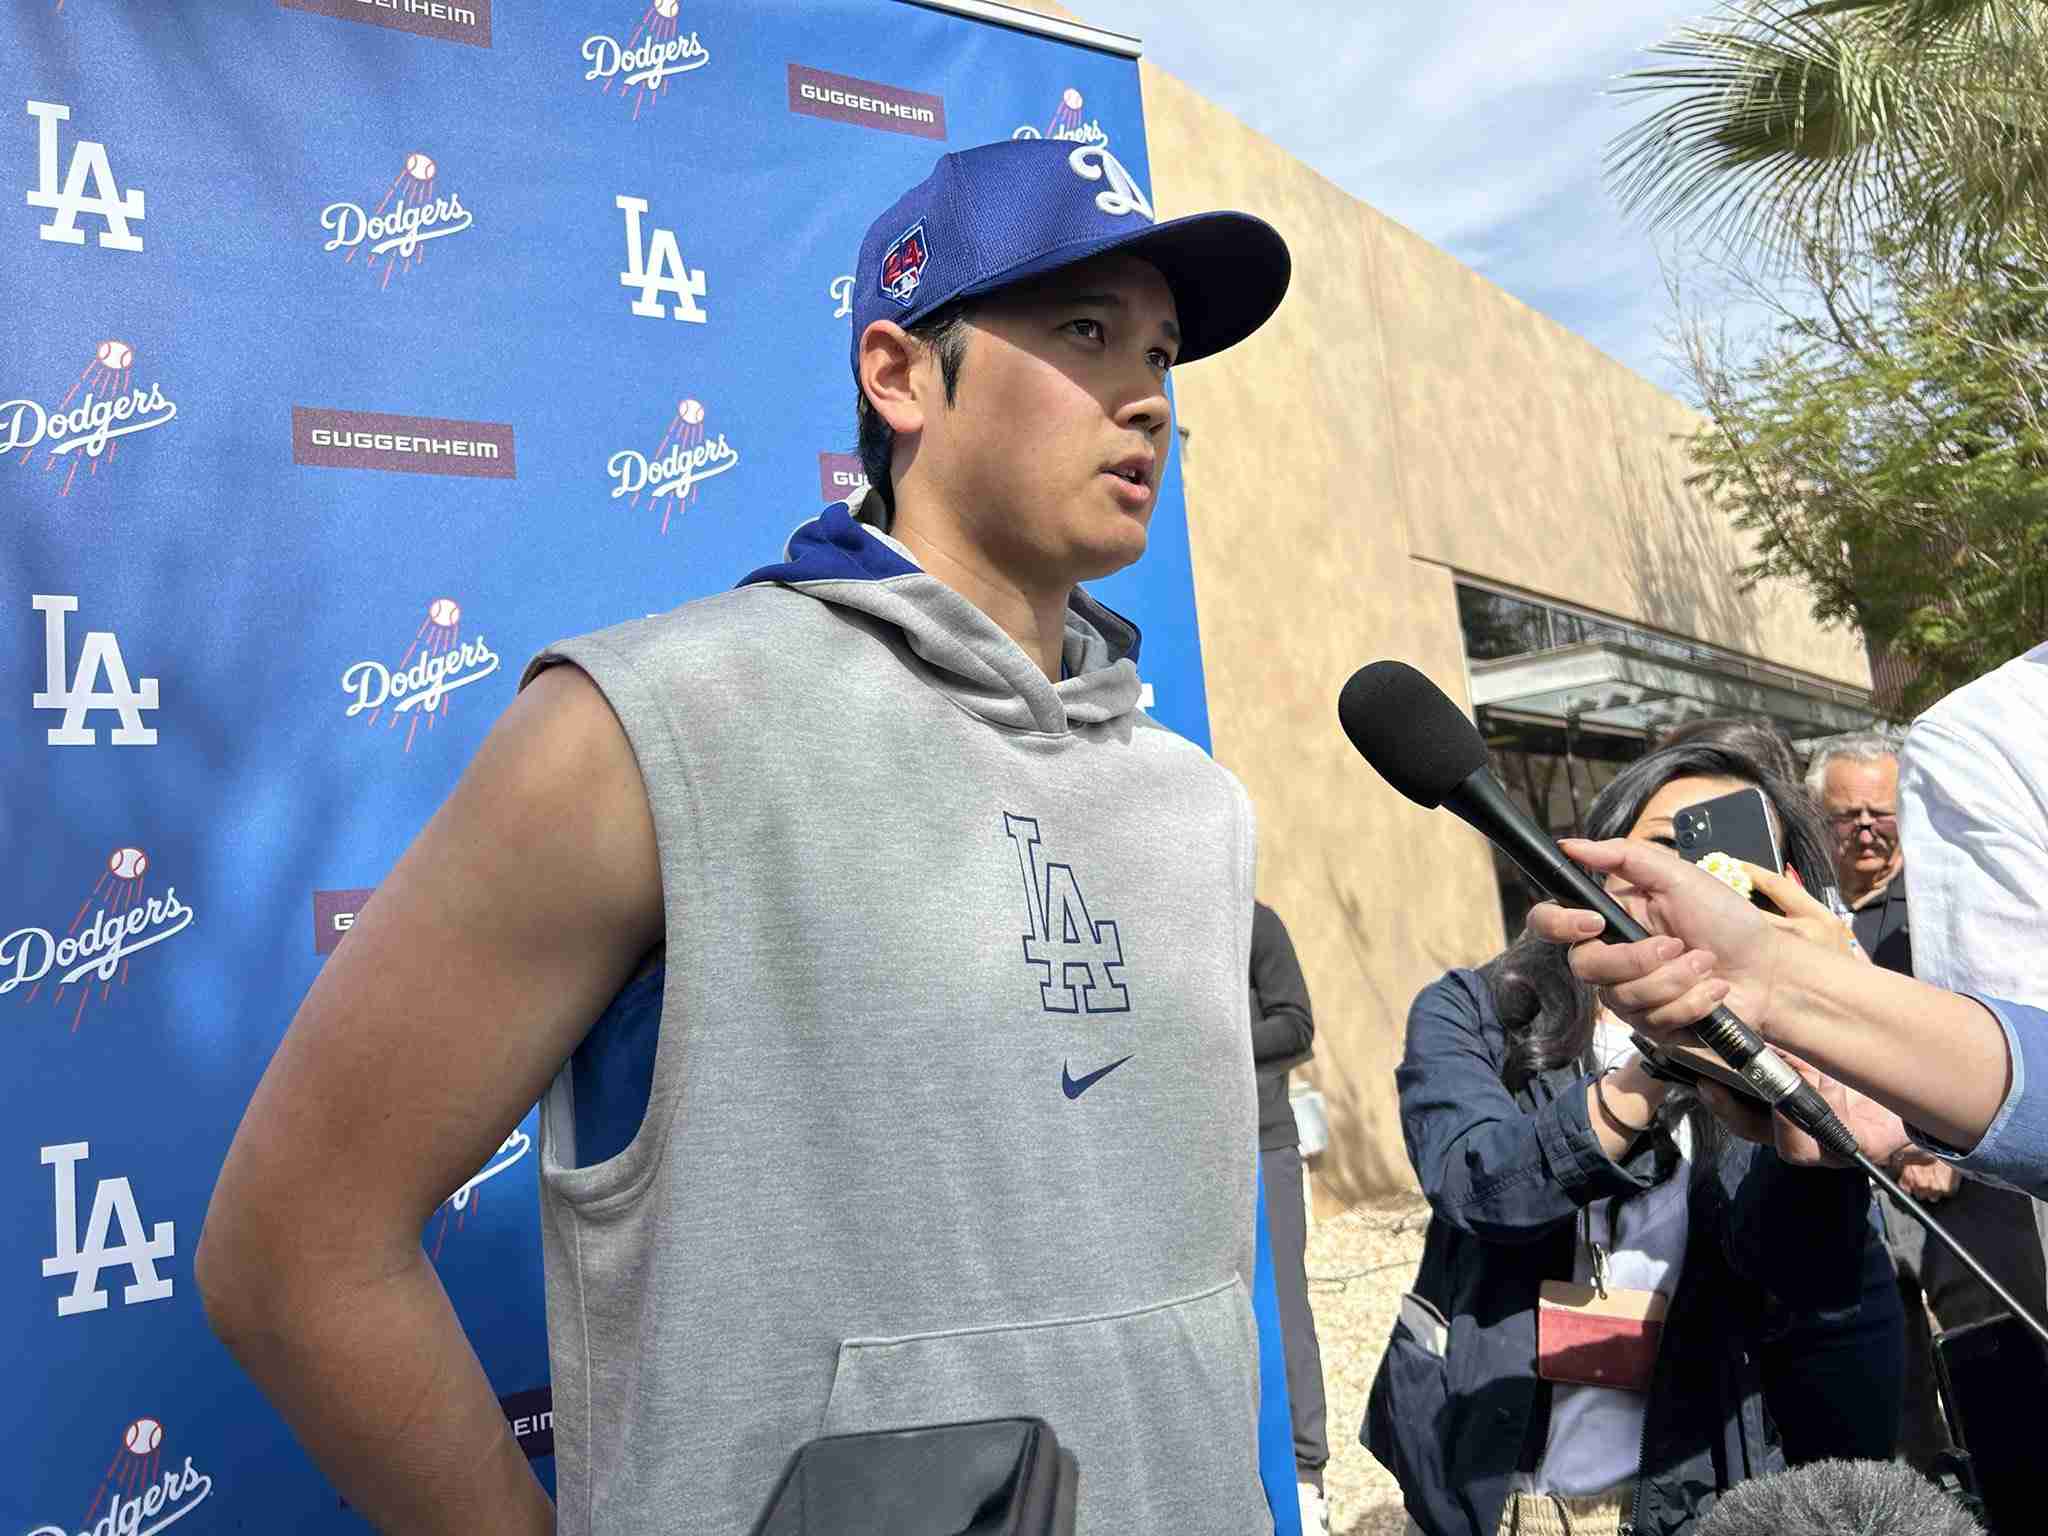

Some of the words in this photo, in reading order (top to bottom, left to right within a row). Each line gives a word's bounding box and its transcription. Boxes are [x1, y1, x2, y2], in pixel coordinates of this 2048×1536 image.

[582, 32, 709, 89] Dodgers
[801, 83, 935, 124] GUGGENHEIM
[26, 99, 145, 253] LA
[320, 193, 472, 257] Dodgers
[616, 194, 707, 324] LA
[0, 383, 177, 456] Dodgers
[311, 429, 499, 459] GUGGENHEIM
[608, 434, 738, 499] Dodgers
[32, 594, 160, 746] LA
[342, 636, 500, 717] Dodgers
[0, 888, 194, 994] Dodgers
[1003, 811, 1131, 1015] LA
[41, 1141, 175, 1317] LA
